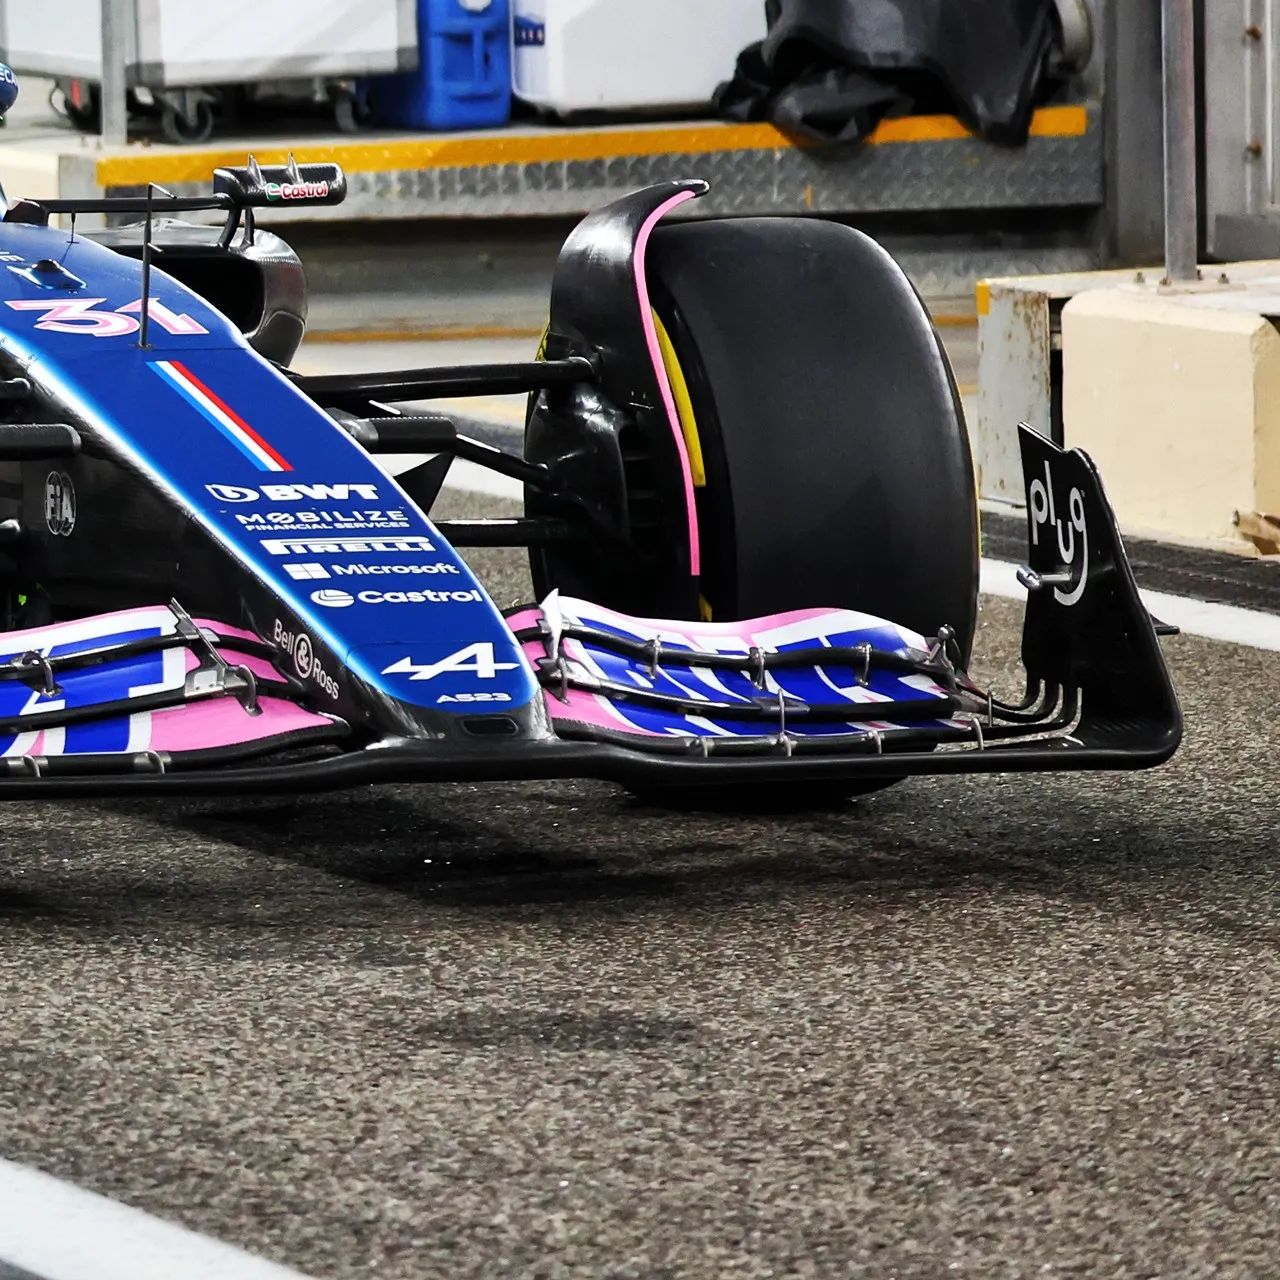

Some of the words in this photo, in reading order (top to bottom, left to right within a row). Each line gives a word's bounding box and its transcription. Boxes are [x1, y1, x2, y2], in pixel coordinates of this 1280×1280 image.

[281, 181, 329, 200] Castrol
[3, 297, 210, 338] 31
[259, 483, 380, 501] BWT
[245, 522, 334, 532] FINANCIAL
[334, 521, 411, 530] SERVICES
[1029, 460, 1089, 606] plug
[259, 535, 437, 556] PIRELLI
[330, 562, 460, 576] Microsoft
[357, 589, 483, 604] Castrol
[274, 618, 294, 656] Bell
[437, 692, 512, 703] A523
